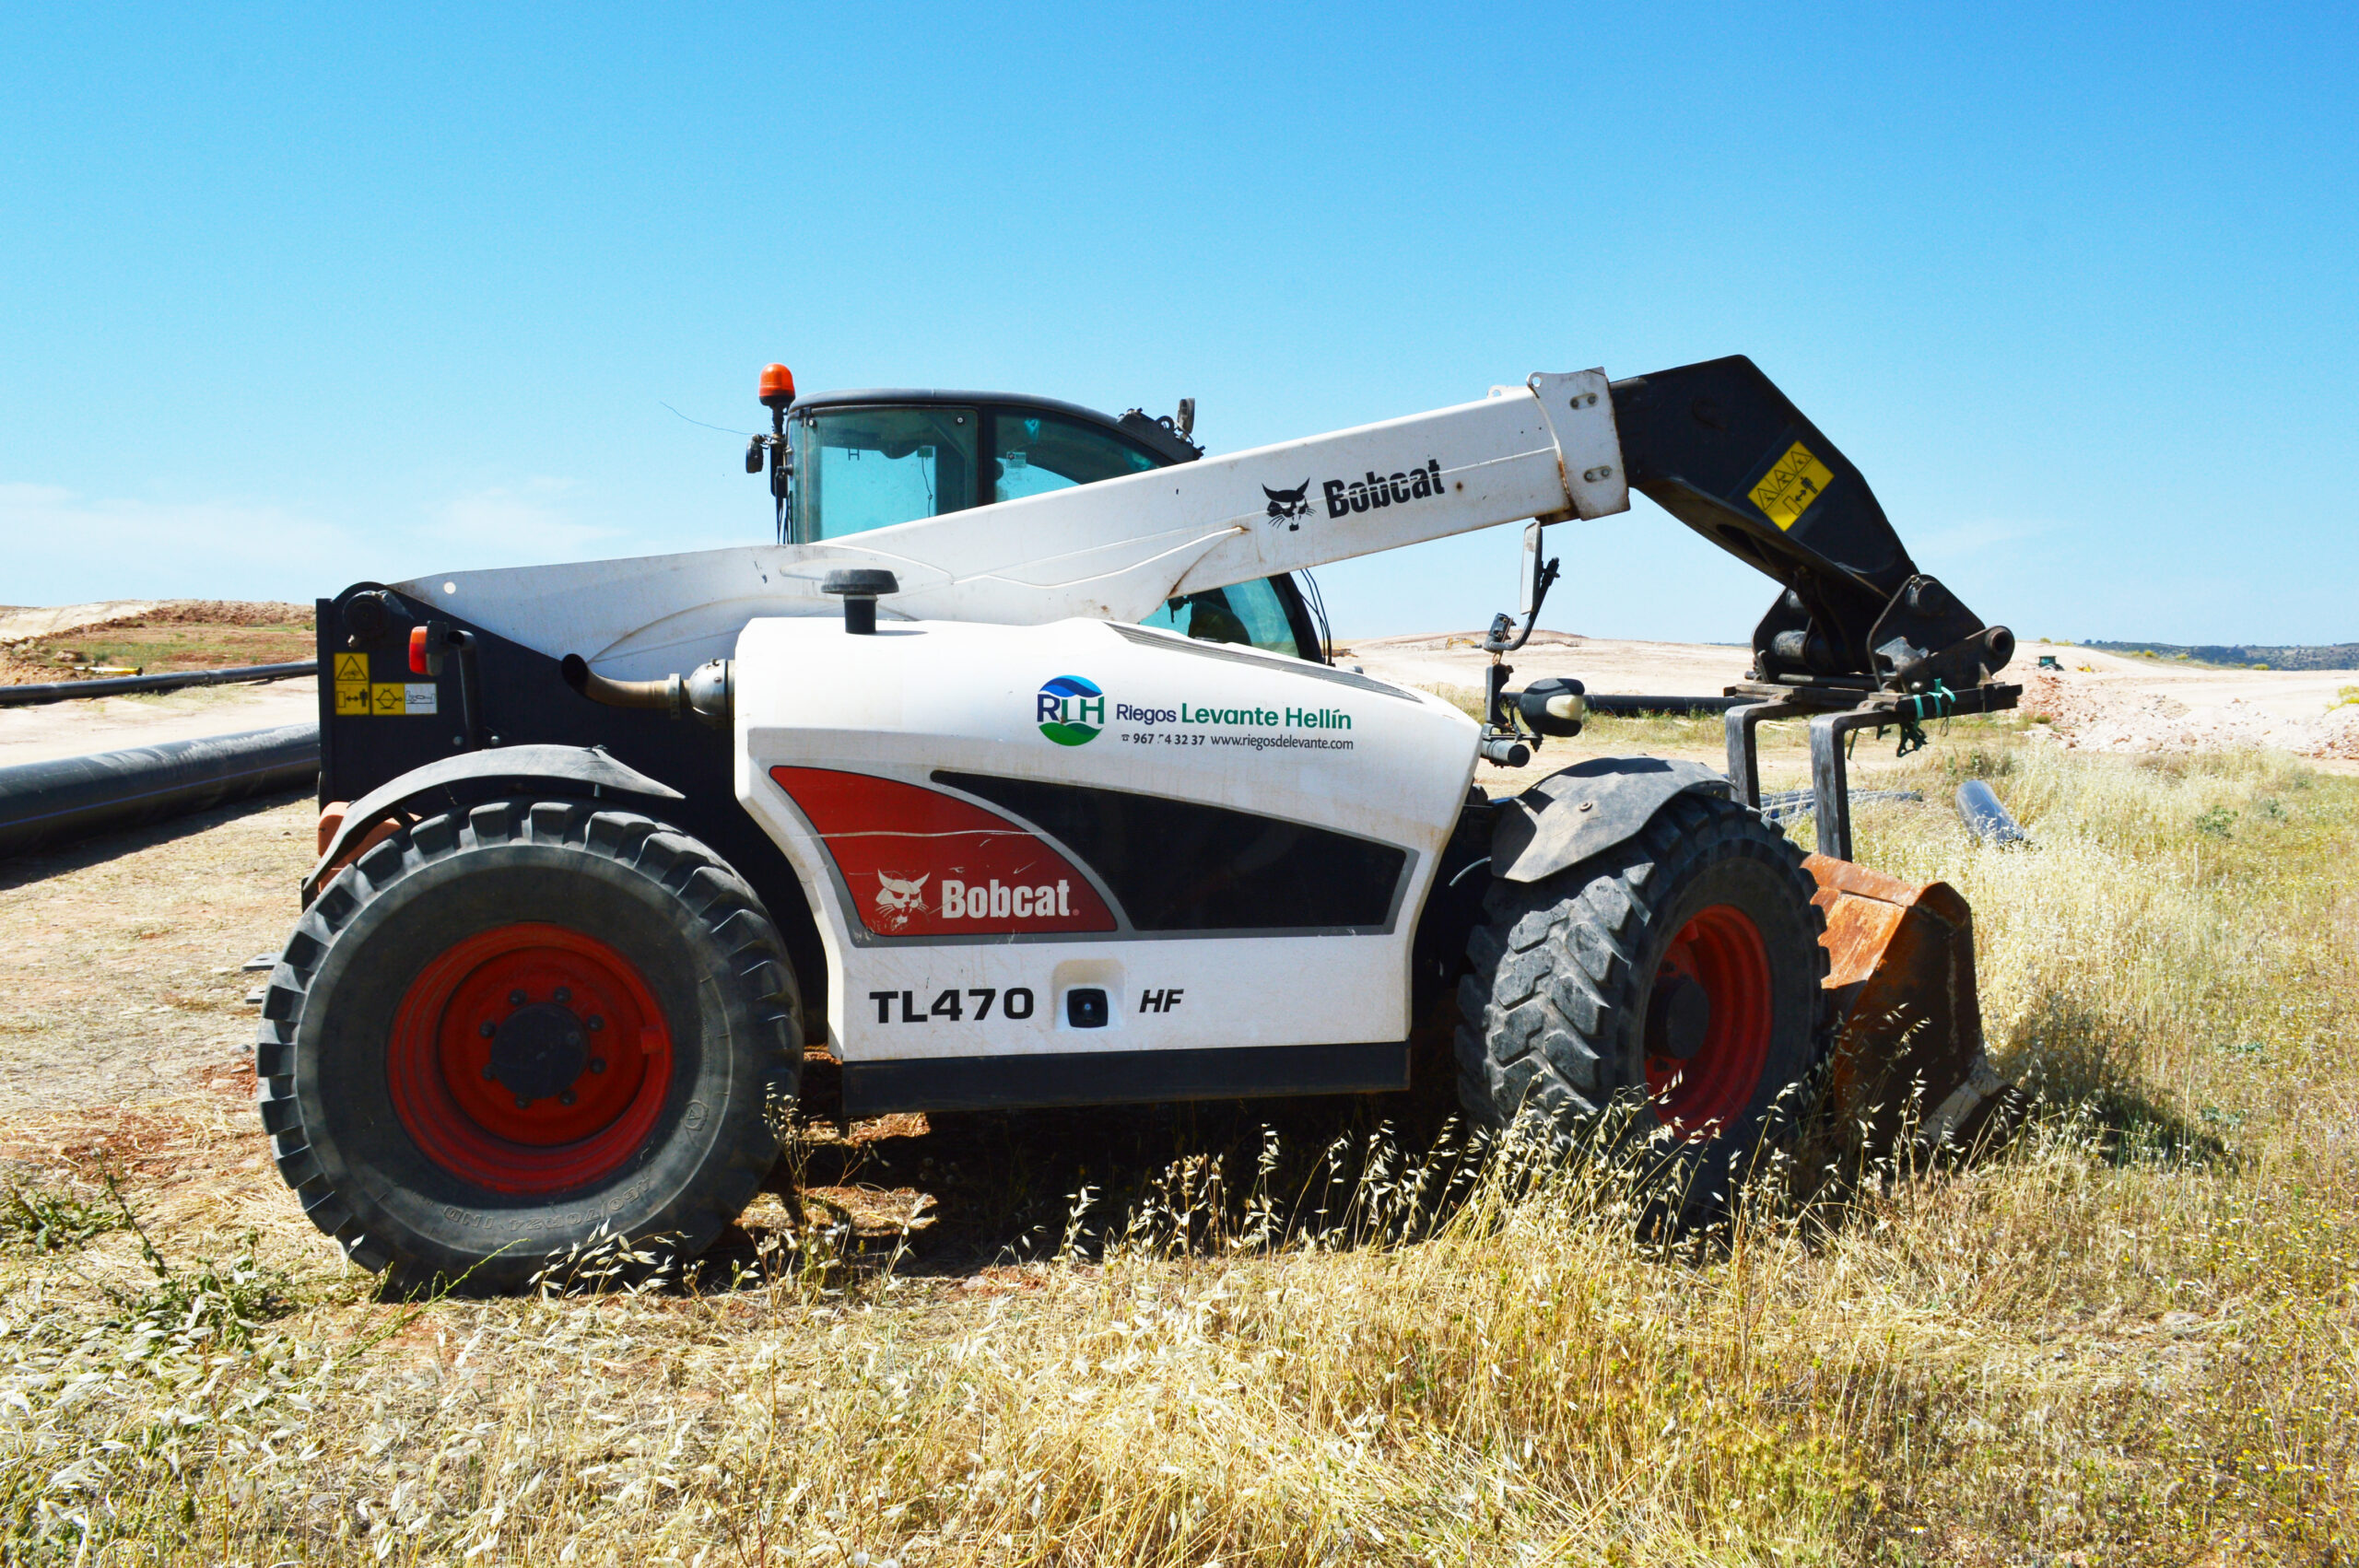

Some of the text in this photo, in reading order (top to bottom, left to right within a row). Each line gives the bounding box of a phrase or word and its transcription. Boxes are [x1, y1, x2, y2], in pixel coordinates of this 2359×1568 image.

[1322, 459, 1445, 519] Bobcat
[1037, 694, 1105, 724] RLH
[1116, 703, 1352, 730] Riegos Levante Hellín
[1133, 732, 1155, 744] 967
[1174, 734, 1189, 745] 32
[1191, 735, 1206, 745] 37
[1210, 733, 1354, 751] www.riegosdelevante.com
[941, 879, 1071, 919] Bobcat
[869, 987, 1185, 1024] TL470 HF
